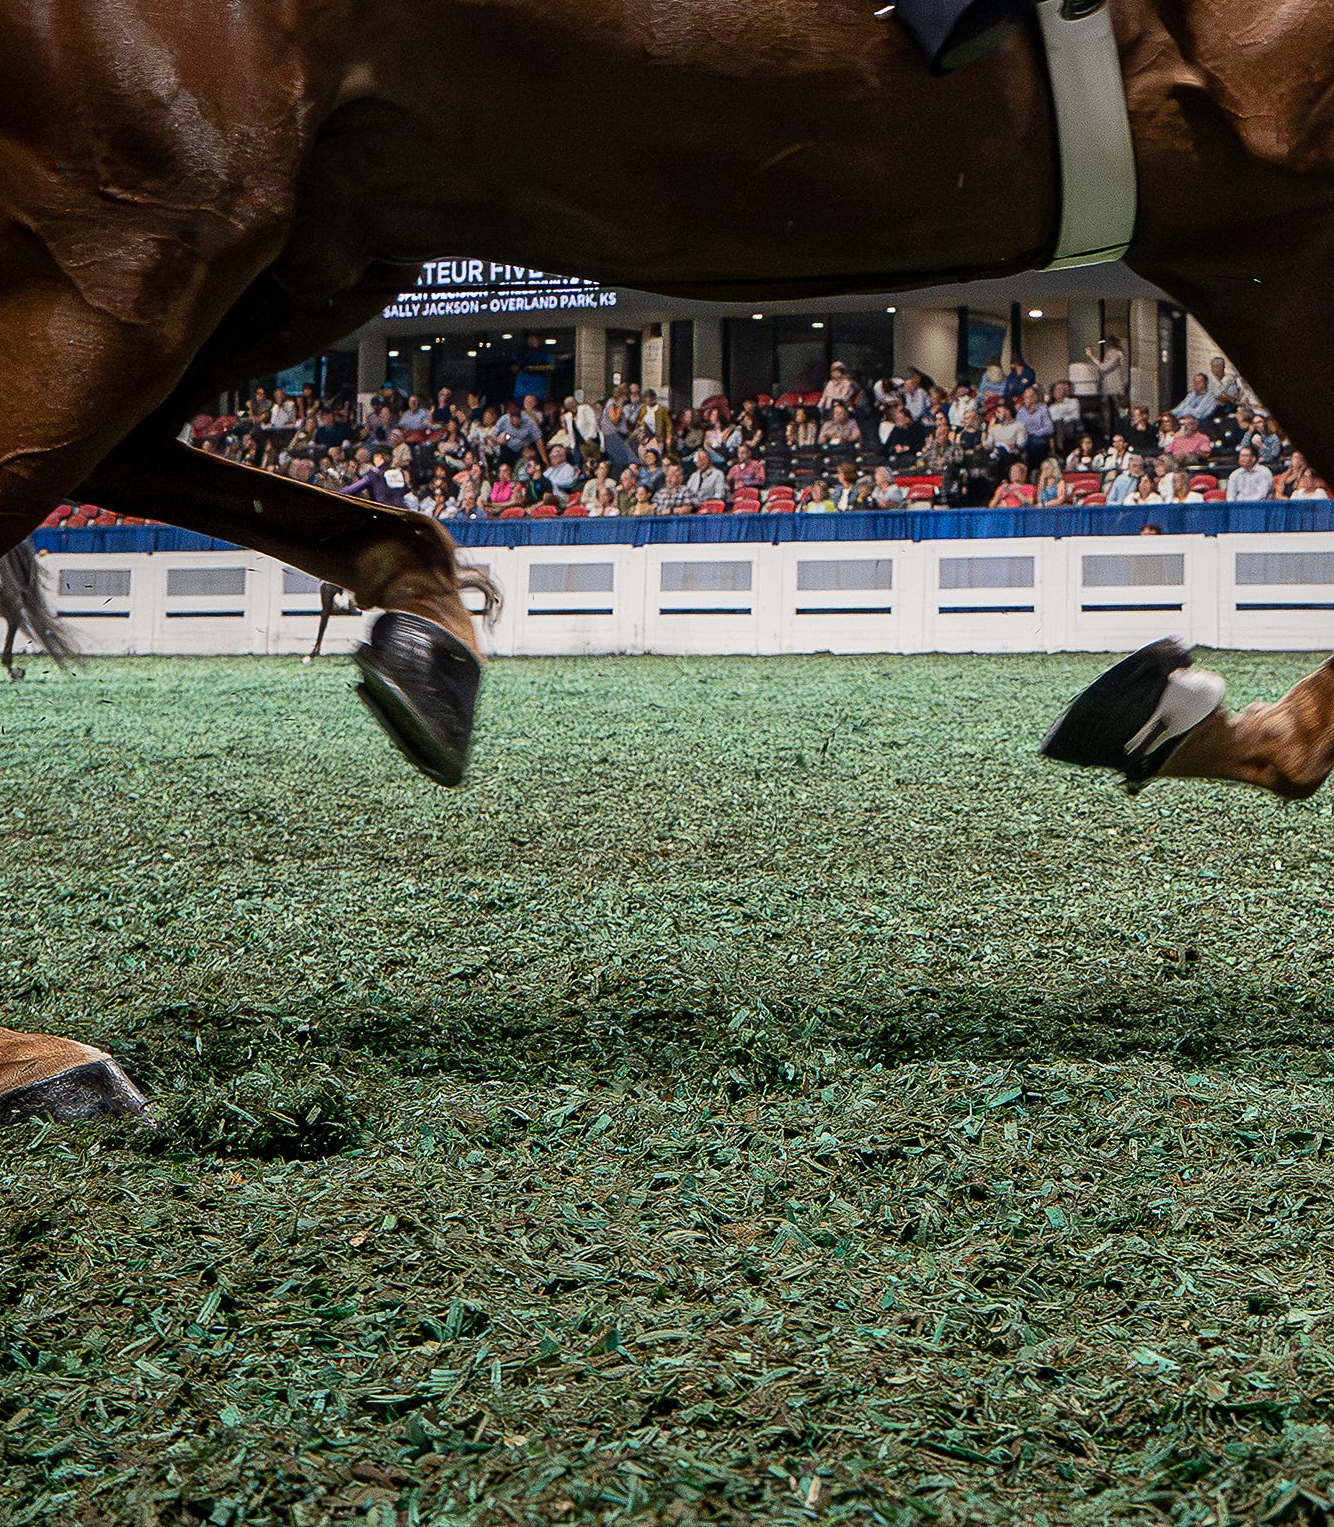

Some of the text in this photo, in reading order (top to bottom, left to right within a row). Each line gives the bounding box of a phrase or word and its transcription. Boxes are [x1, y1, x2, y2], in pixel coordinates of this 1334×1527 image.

[417, 260, 484, 286] TEUR
[382, 303, 420, 319] SALLY
[422, 300, 479, 316] JACKSON
[489, 295, 558, 313] OVERLAND
[559, 292, 597, 309] PARK,
[599, 291, 617, 306] KS
